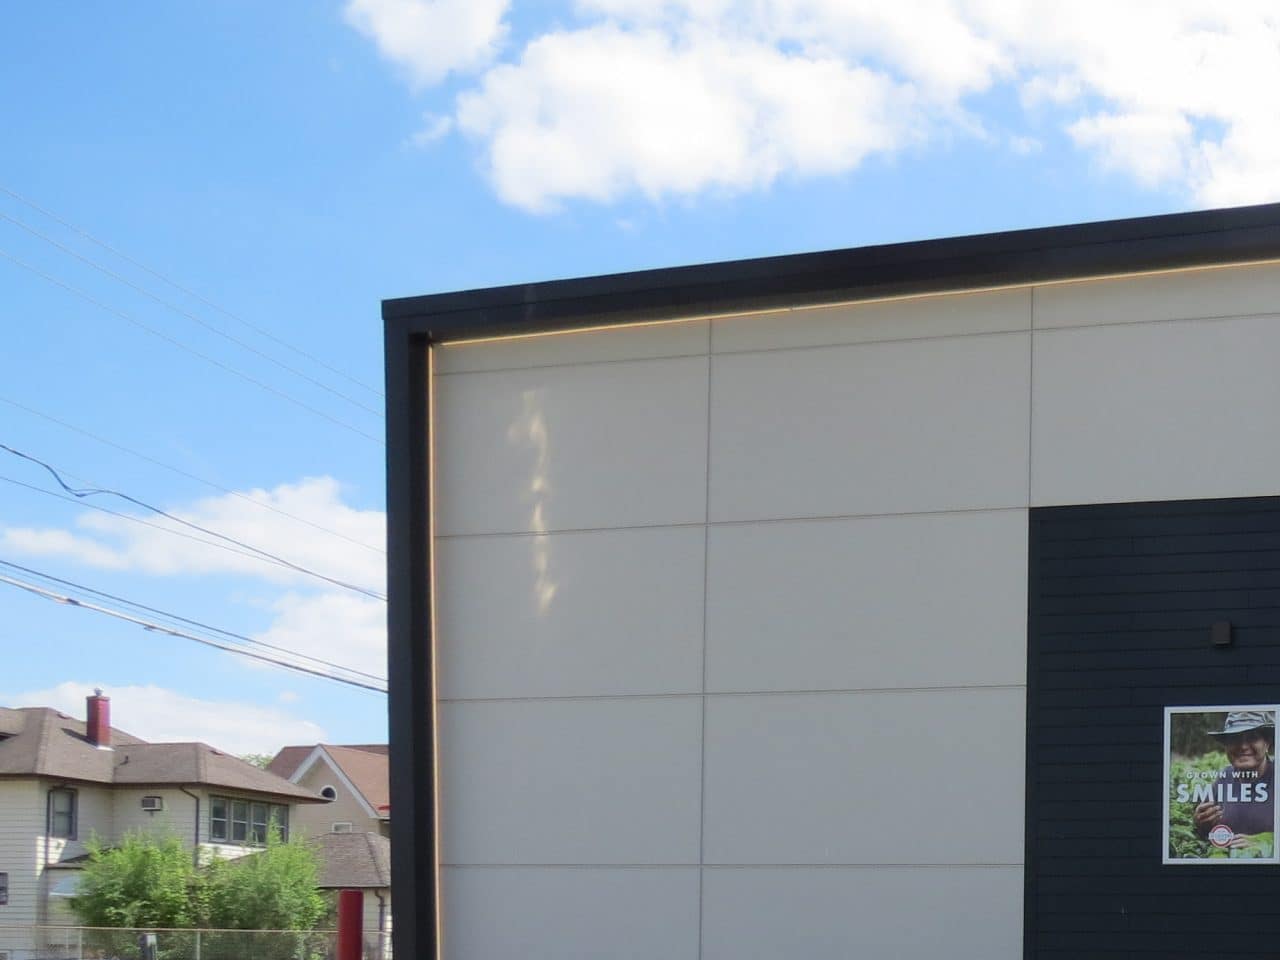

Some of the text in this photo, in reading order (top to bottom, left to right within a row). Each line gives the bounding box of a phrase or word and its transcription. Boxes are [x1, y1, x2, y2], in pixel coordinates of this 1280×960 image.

[1186, 770, 1259, 779] GROWN WITH
[1176, 783, 1269, 803] SMILES
